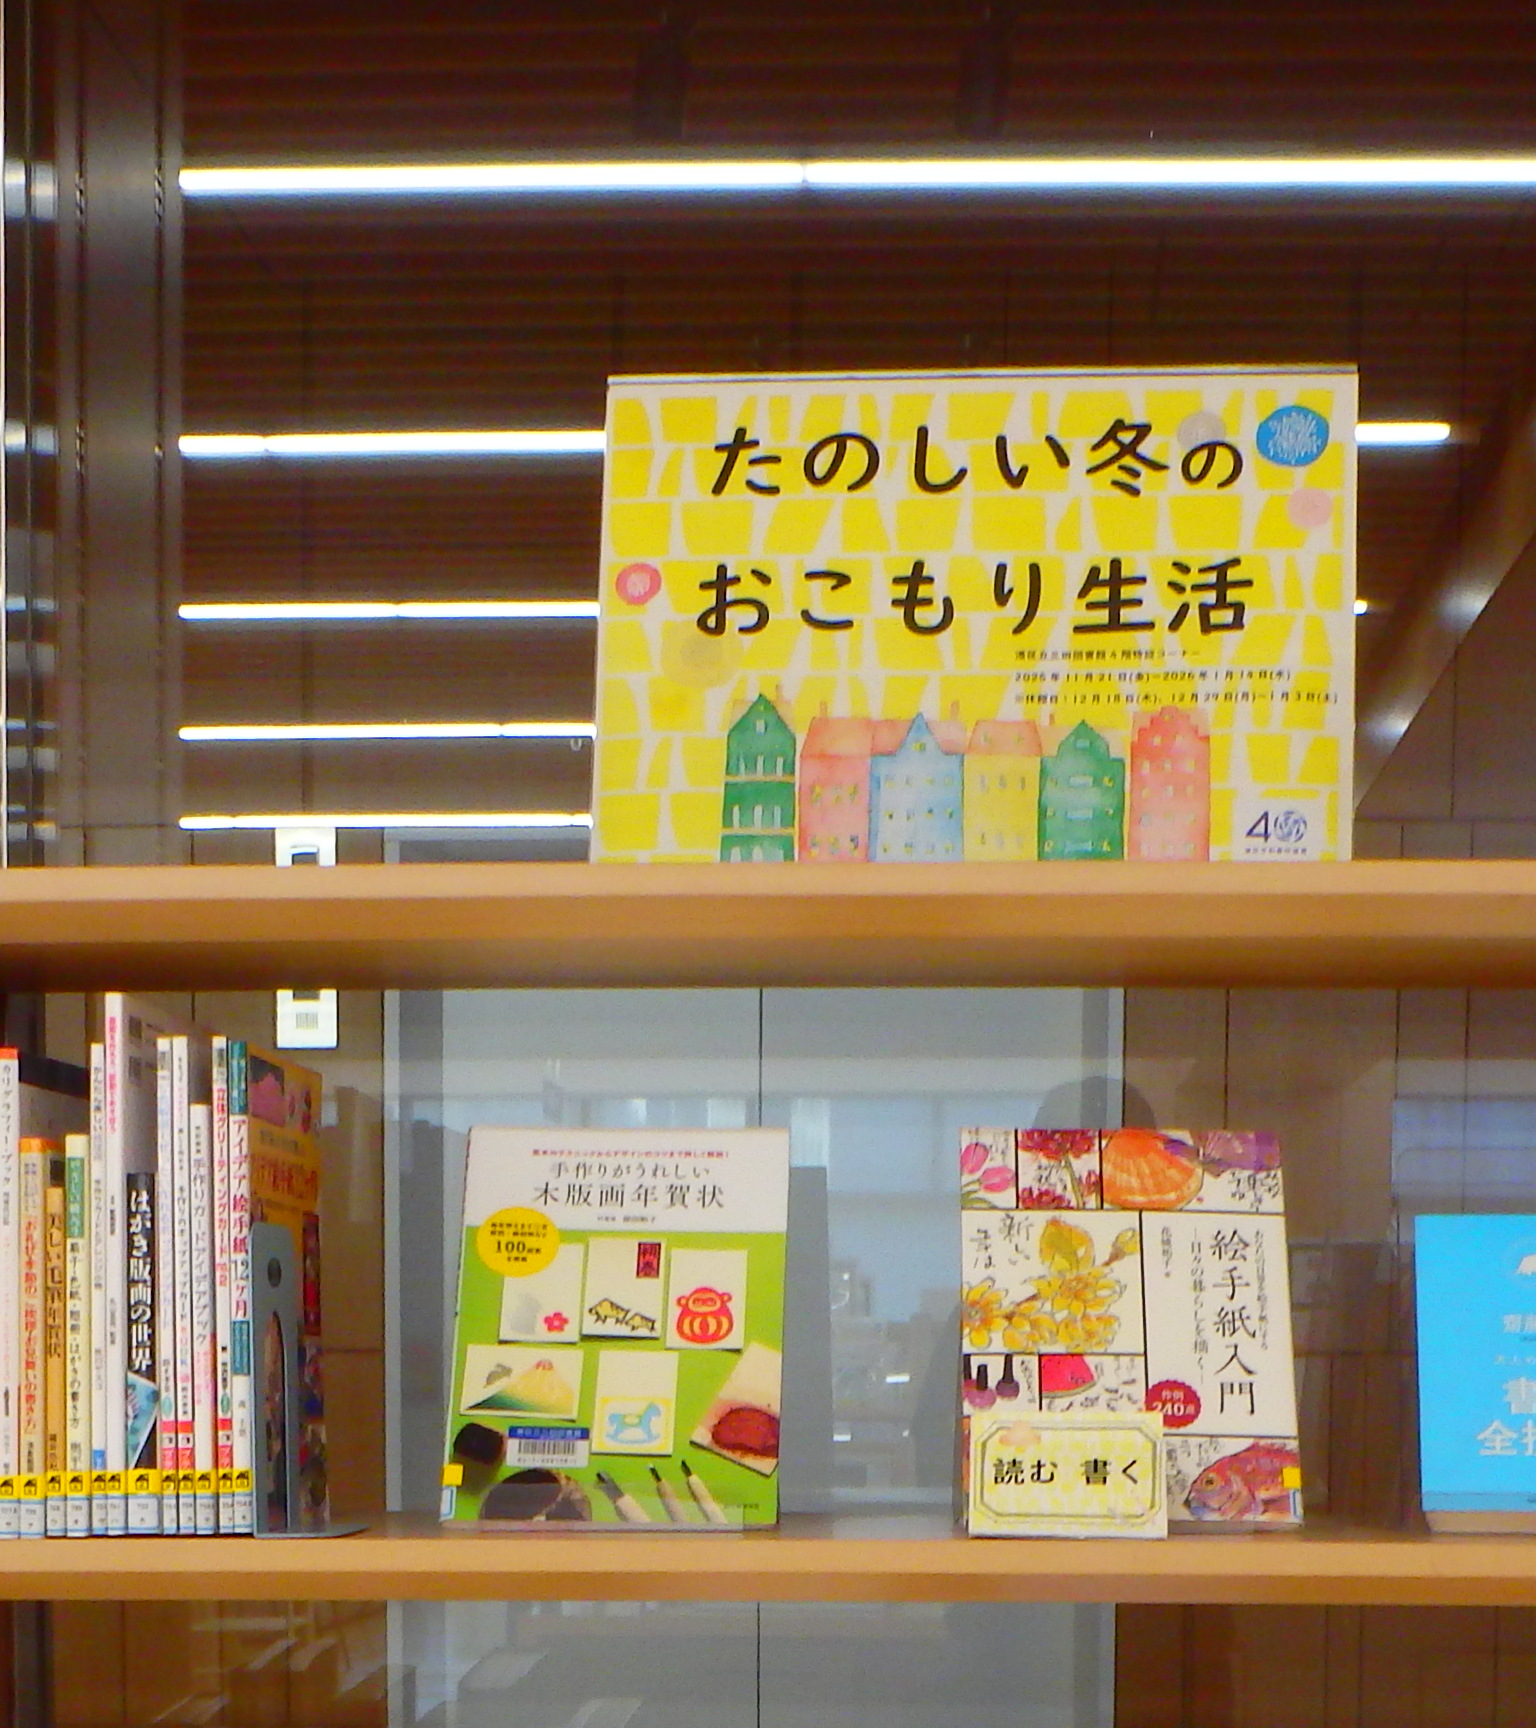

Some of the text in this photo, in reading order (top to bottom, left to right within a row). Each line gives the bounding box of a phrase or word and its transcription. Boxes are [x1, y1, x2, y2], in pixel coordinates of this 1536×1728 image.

[711, 418, 1244, 498] たのしい冬の
[696, 557, 1255, 636] おこもり生活
[533, 1181, 725, 1209] 木版画年賀状
[551, 1161, 710, 1181] 手作りがうれしい
[129, 1189, 153, 1372] はがき版画の世界
[1209, 1228, 1258, 1416] 絵手紙入門
[992, 1457, 1140, 1486] 読む 書く
